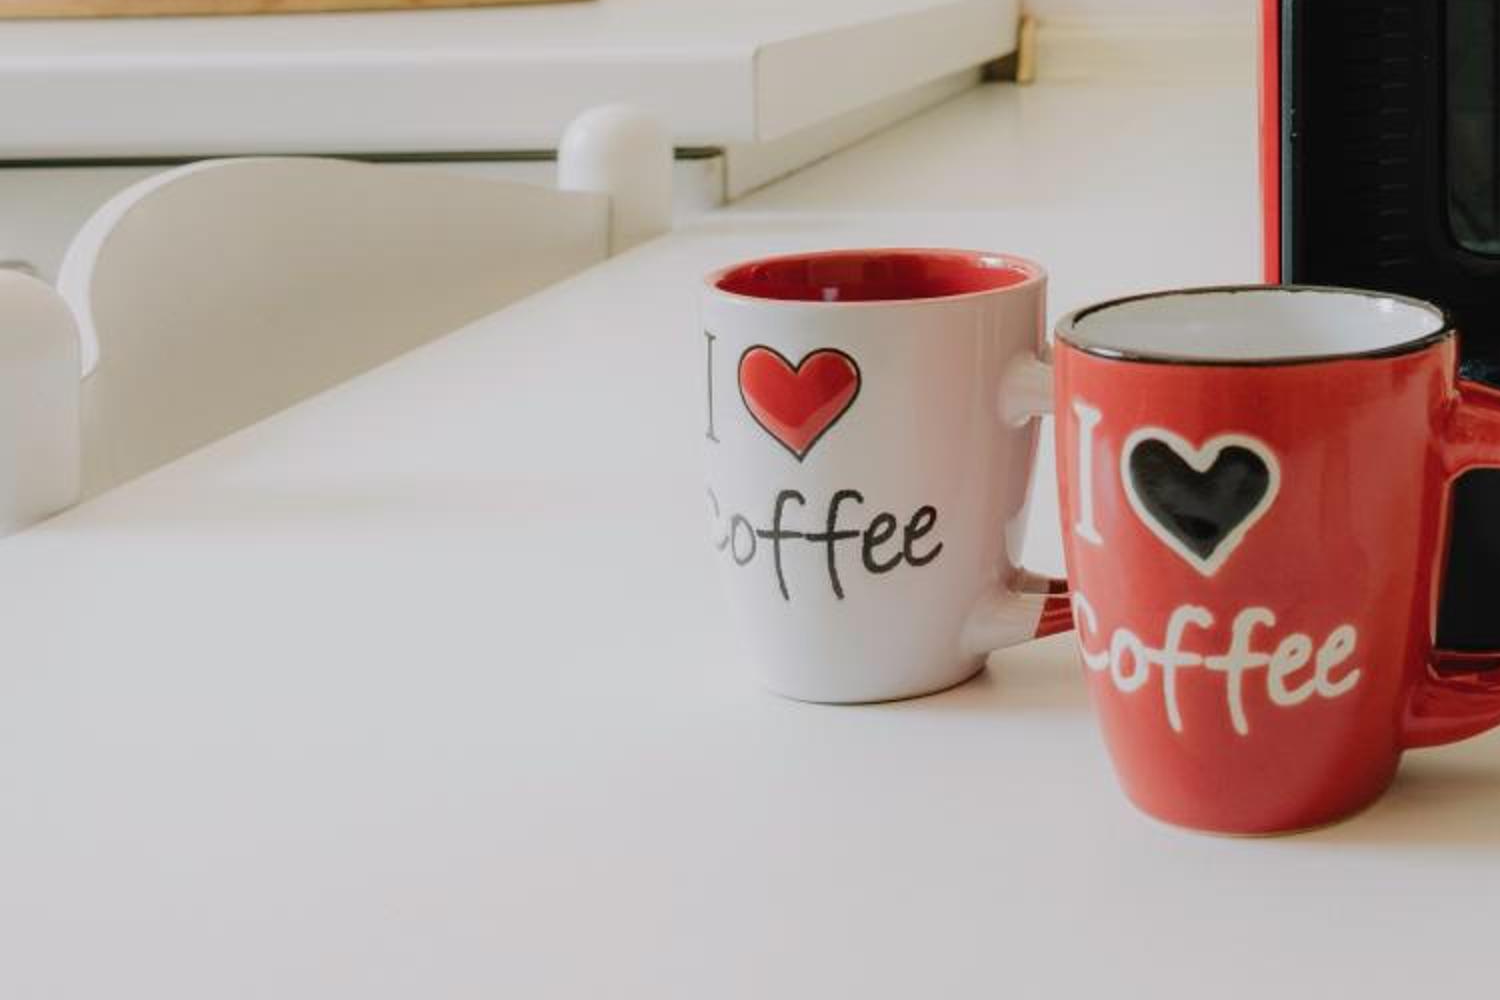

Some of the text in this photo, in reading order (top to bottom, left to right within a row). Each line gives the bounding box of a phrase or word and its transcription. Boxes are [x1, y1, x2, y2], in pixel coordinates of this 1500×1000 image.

[704, 330, 721, 444] I
[1073, 396, 1104, 546] I
[1073, 590, 1361, 735] Coffee
